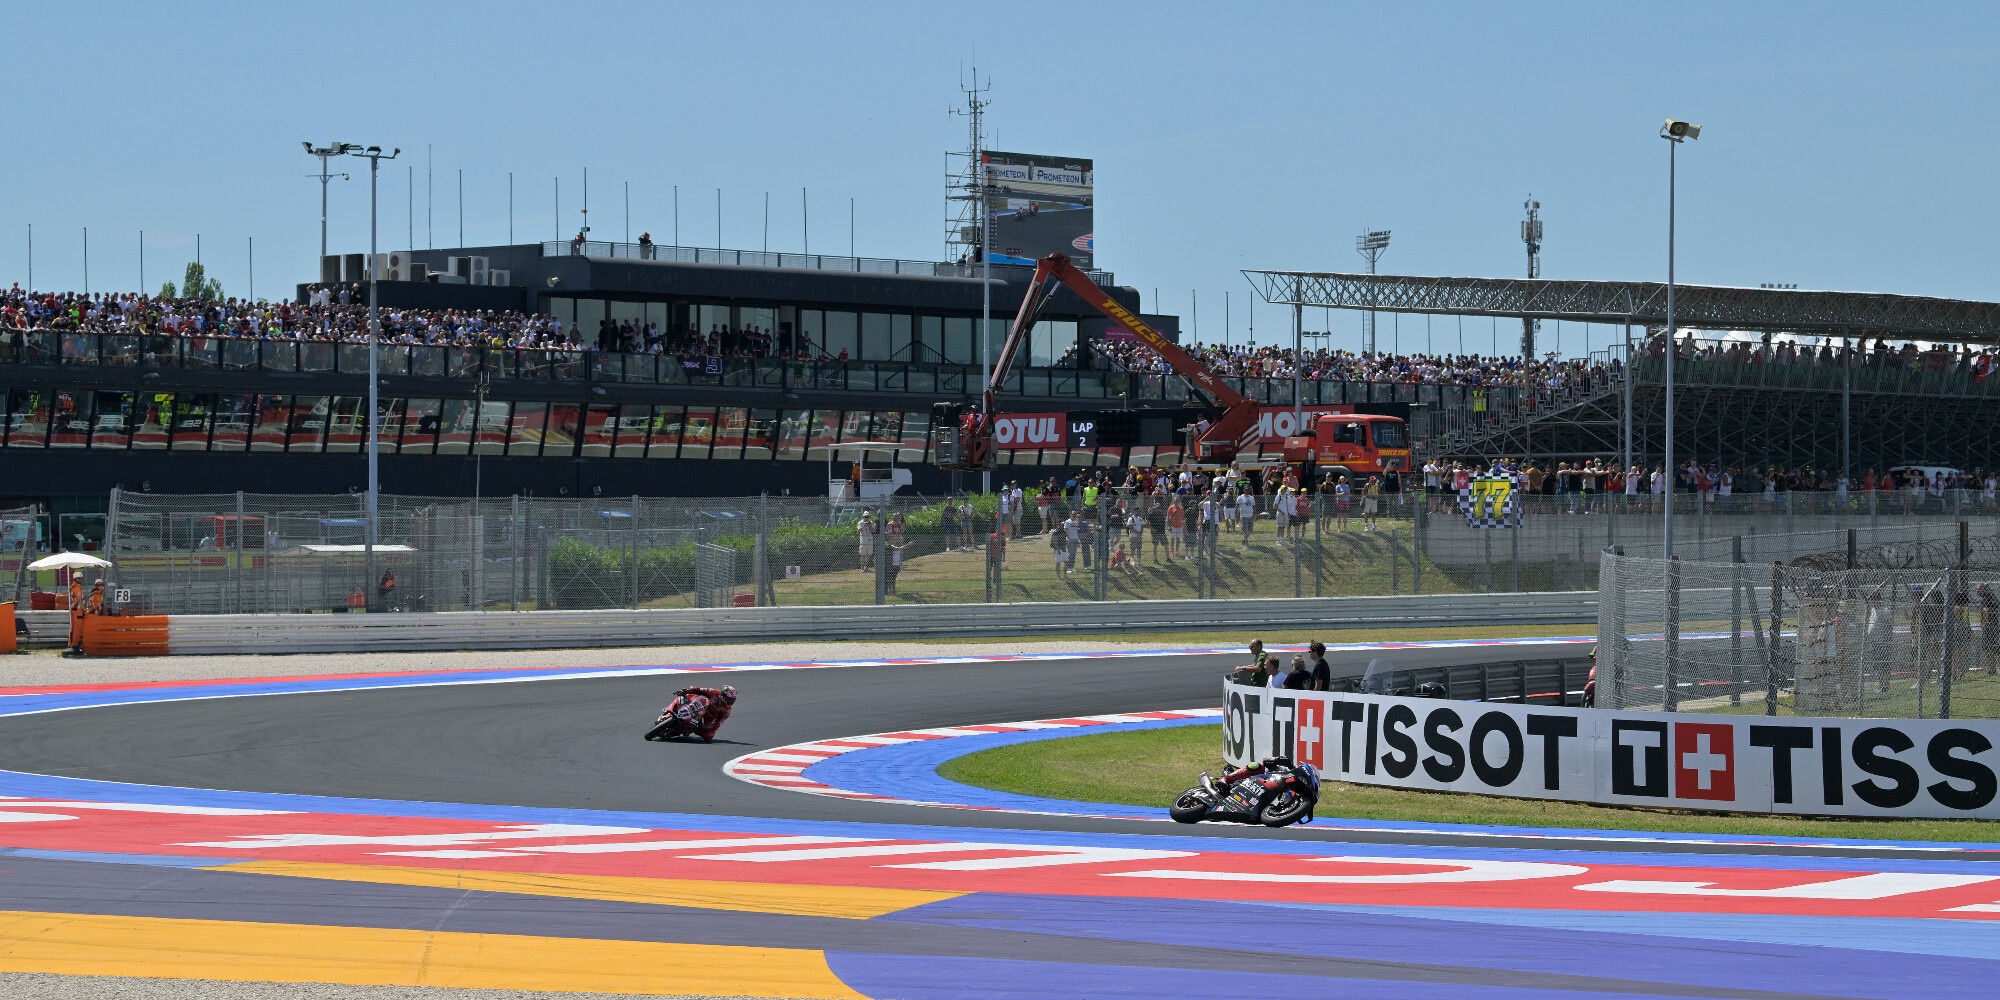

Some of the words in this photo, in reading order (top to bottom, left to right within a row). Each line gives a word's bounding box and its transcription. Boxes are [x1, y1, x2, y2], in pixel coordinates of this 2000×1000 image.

[1037, 170, 1080, 183] PROMETEON
[995, 418, 1060, 443] OTUL
[1072, 422, 1094, 433] LAP
[1079, 437, 1086, 447] 2
[1472, 479, 1511, 519] 77
[1223, 687, 1260, 762] SOT
[1332, 701, 1578, 791] TISSOT
[1749, 725, 1999, 810] TISS
